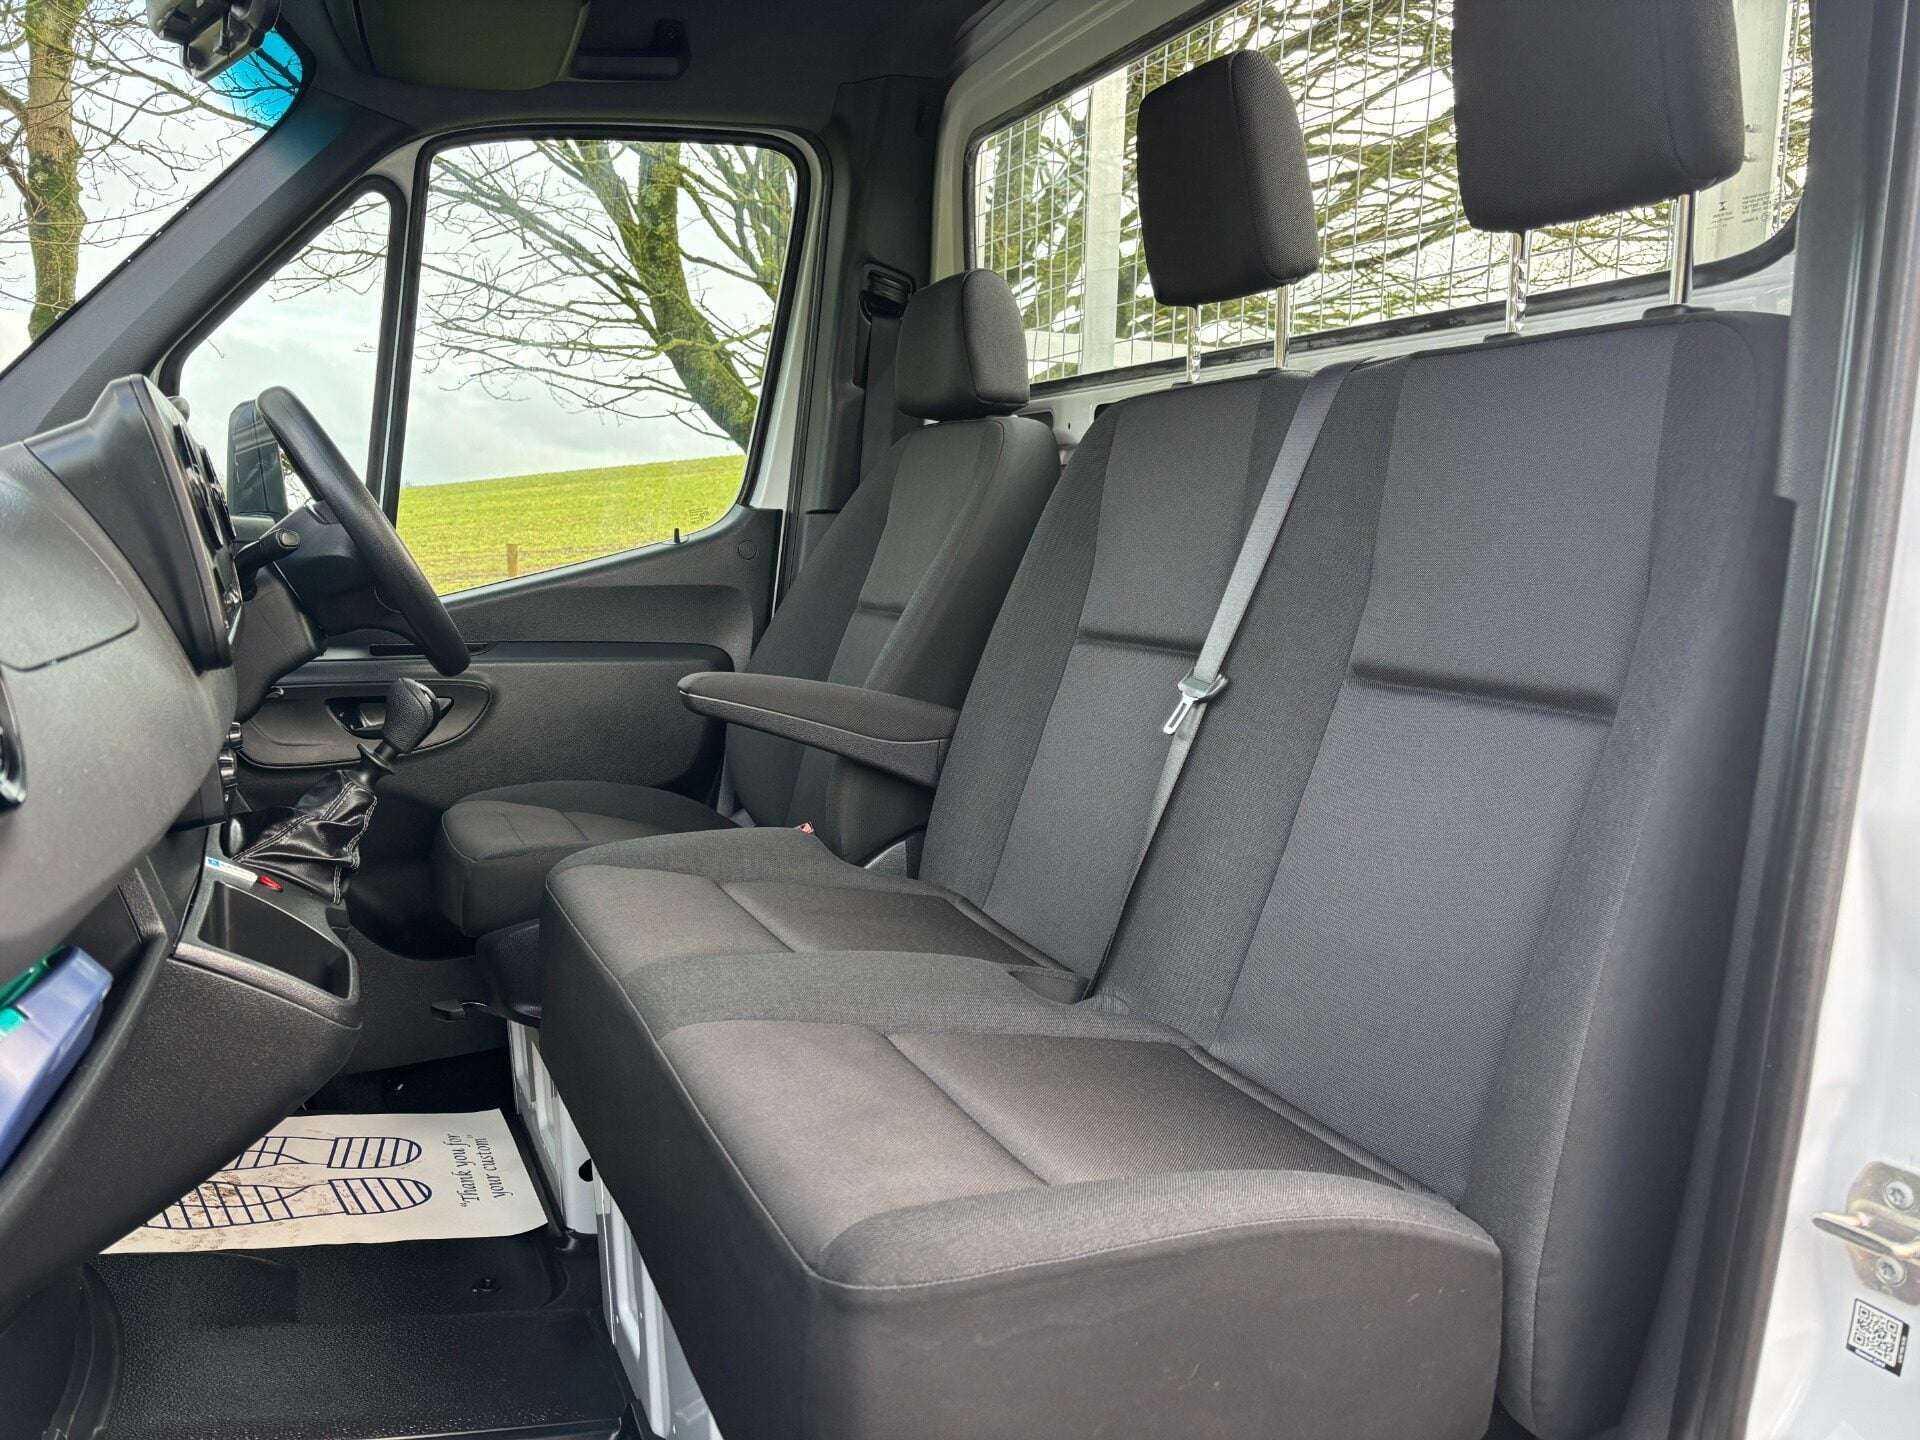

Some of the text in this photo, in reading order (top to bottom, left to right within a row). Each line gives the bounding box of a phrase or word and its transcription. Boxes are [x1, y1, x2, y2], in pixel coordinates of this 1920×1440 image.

[443, 1133, 471, 1148] for
[452, 1149, 476, 1167] you
[486, 1174, 514, 1198] your
